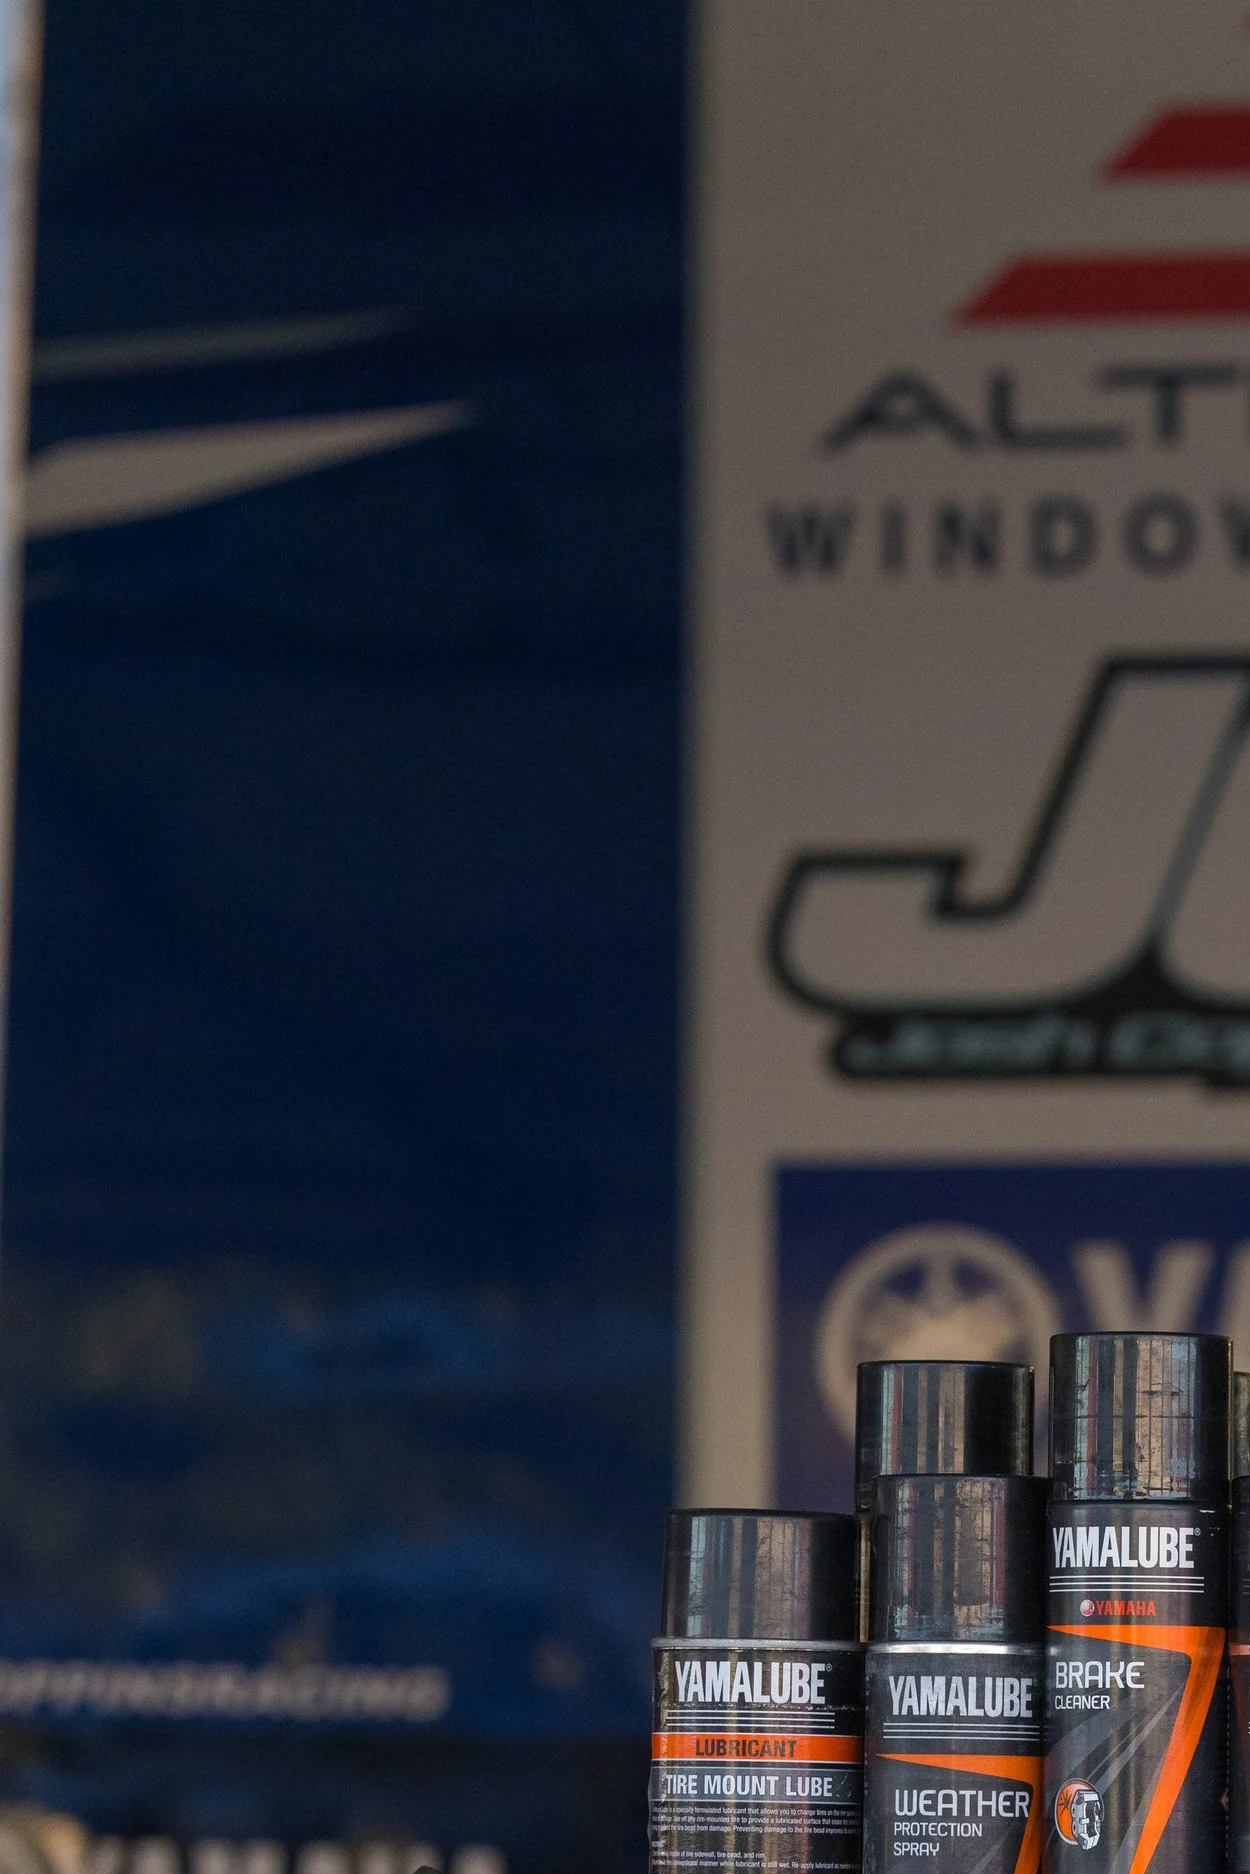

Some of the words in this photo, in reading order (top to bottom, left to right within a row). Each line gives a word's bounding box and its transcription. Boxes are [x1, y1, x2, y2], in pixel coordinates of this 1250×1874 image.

[1096, 1600, 1156, 1616] YAMAHA
[1056, 1661, 1144, 1689] BRAKE
[1055, 1695, 1110, 1709] CLEANER
[696, 1739, 798, 1758] LUBRICANT
[666, 1775, 697, 1794] TIRE
[704, 1775, 778, 1796] MOUNT
[786, 1776, 833, 1797] LUBE
[895, 1789, 1029, 1818] WEATHER
[894, 1822, 982, 1837] PROTECTION
[894, 1843, 939, 1856] SPRAY
